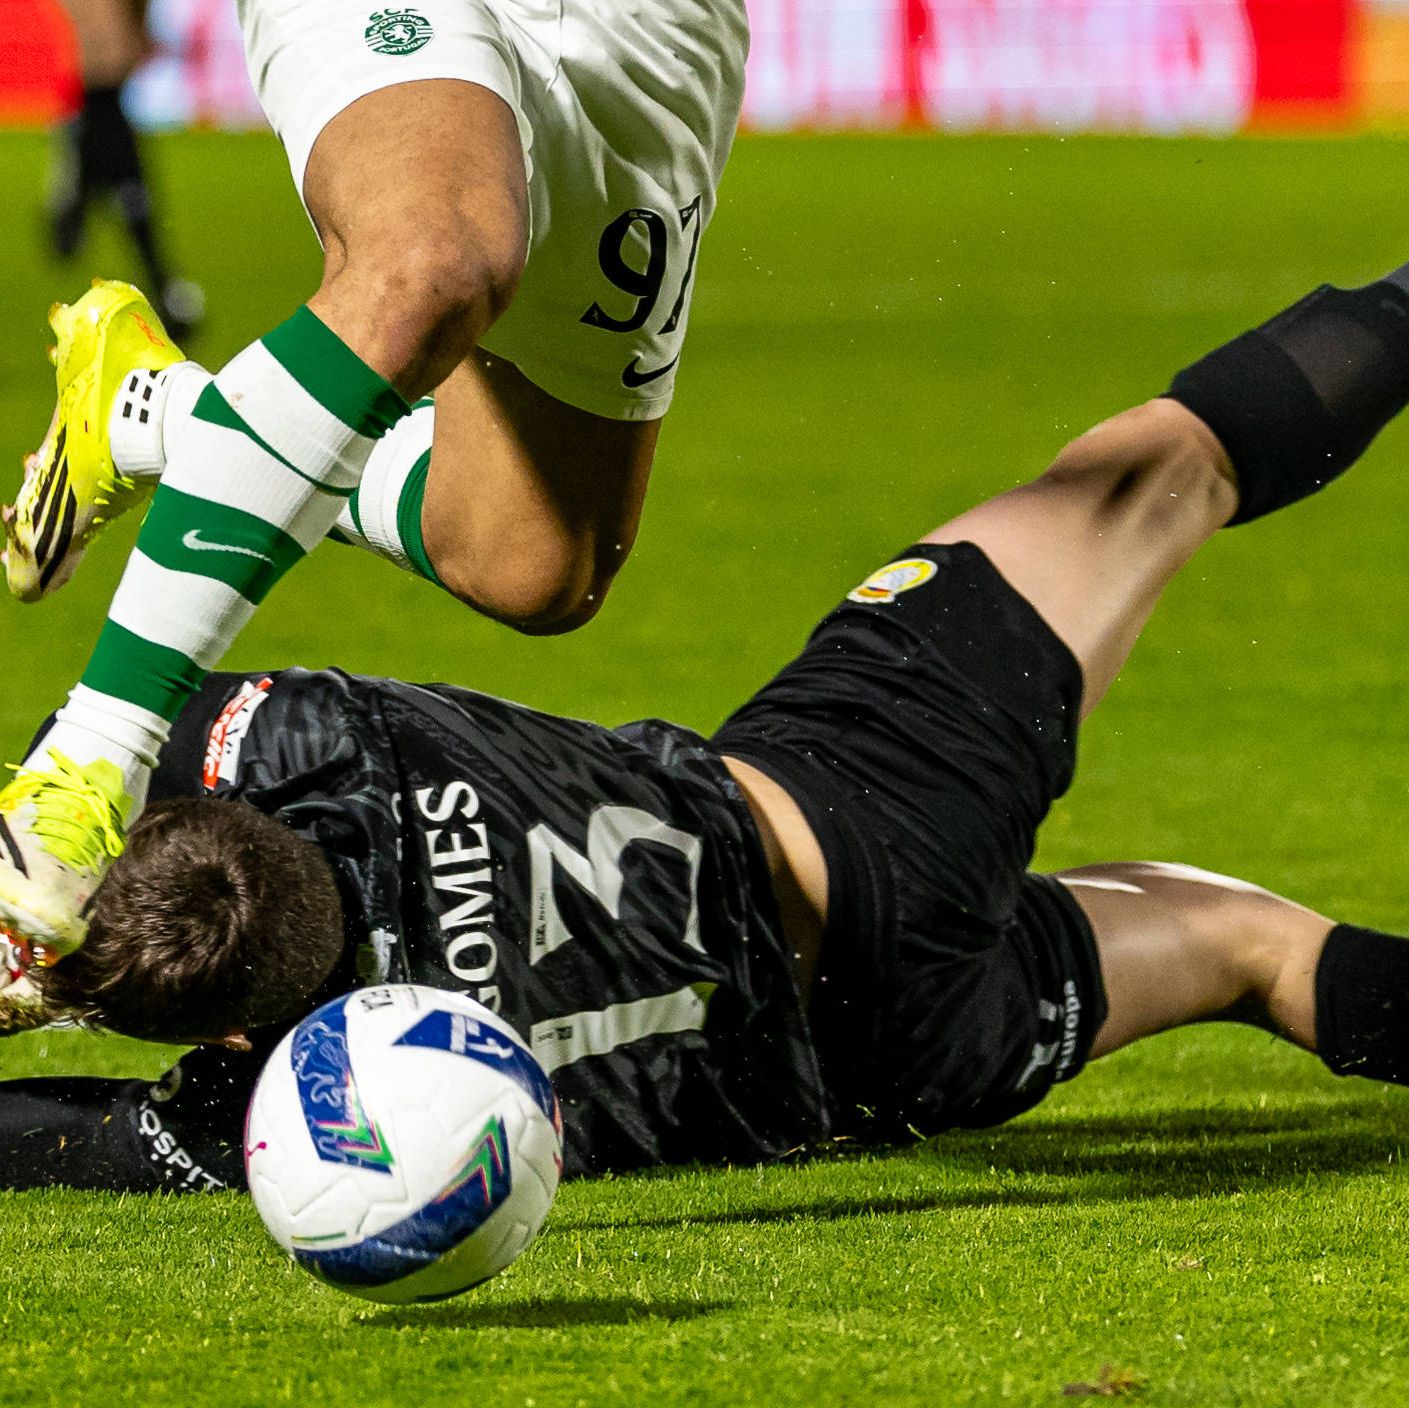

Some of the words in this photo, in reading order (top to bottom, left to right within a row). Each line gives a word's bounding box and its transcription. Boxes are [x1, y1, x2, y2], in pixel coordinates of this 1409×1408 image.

[579, 194, 702, 336] 97
[527, 805, 708, 1076] 13
[139, 1100, 225, 1190] OSPIT
